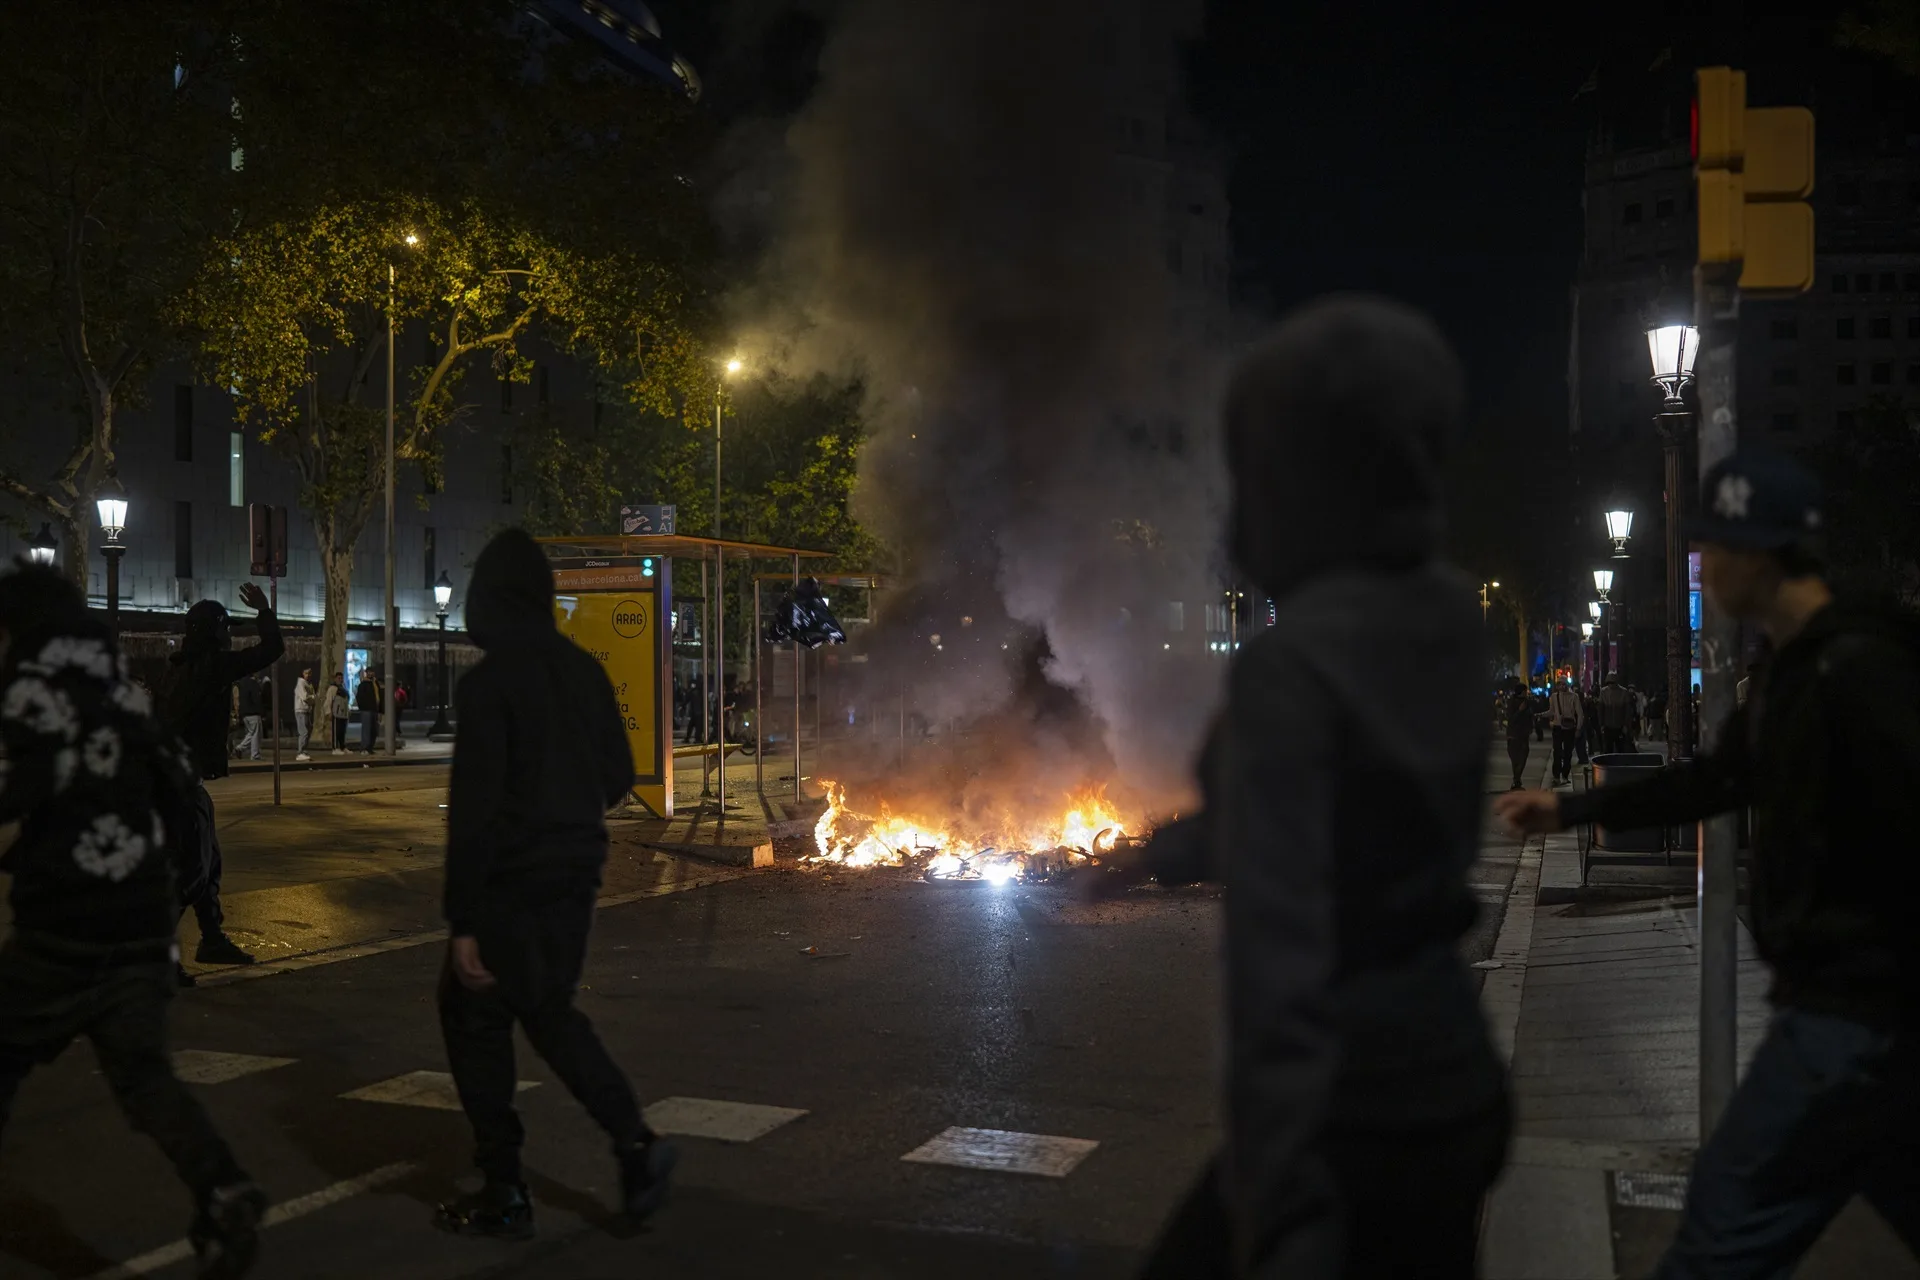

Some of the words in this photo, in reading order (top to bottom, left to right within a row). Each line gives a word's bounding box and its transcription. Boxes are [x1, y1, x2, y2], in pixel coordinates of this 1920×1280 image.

[658, 522, 672, 533] A1
[555, 573, 644, 586] www.barcelona.cat
[616, 613, 643, 625] ARAG
[589, 648, 610, 661] itas
